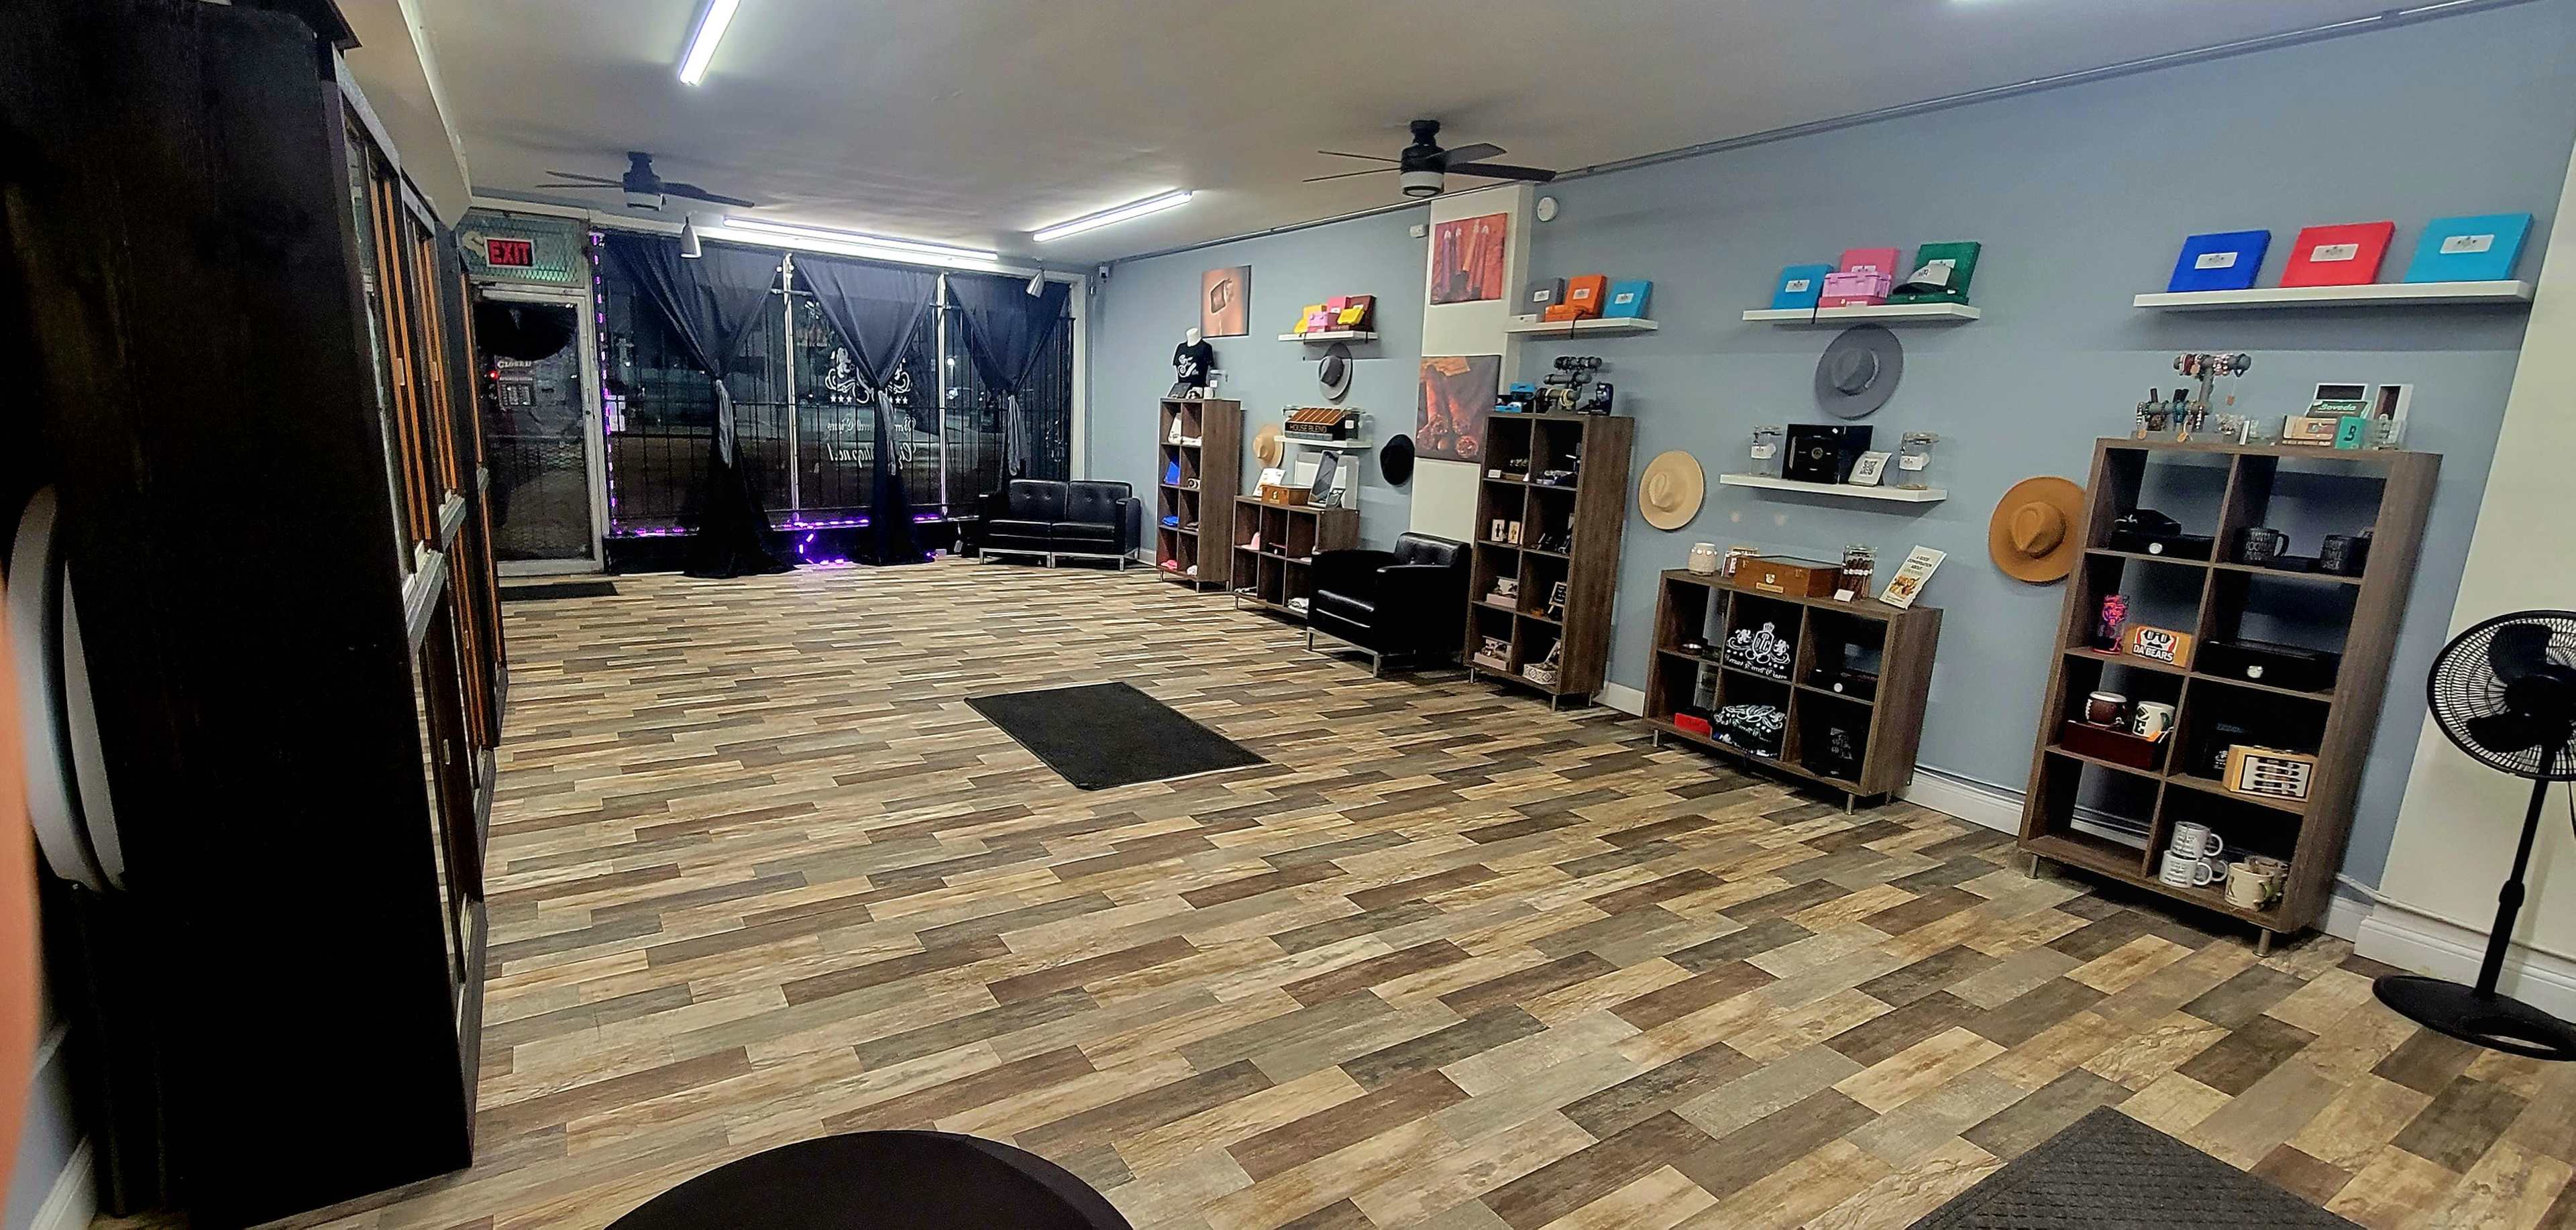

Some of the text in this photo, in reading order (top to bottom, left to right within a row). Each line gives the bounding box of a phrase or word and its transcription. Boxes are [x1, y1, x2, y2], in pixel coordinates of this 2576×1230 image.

[489, 241, 530, 264] EXIT
[1289, 423, 1327, 433] HOUSE BLEND
[2133, 644, 2174, 662] DA BEARS
